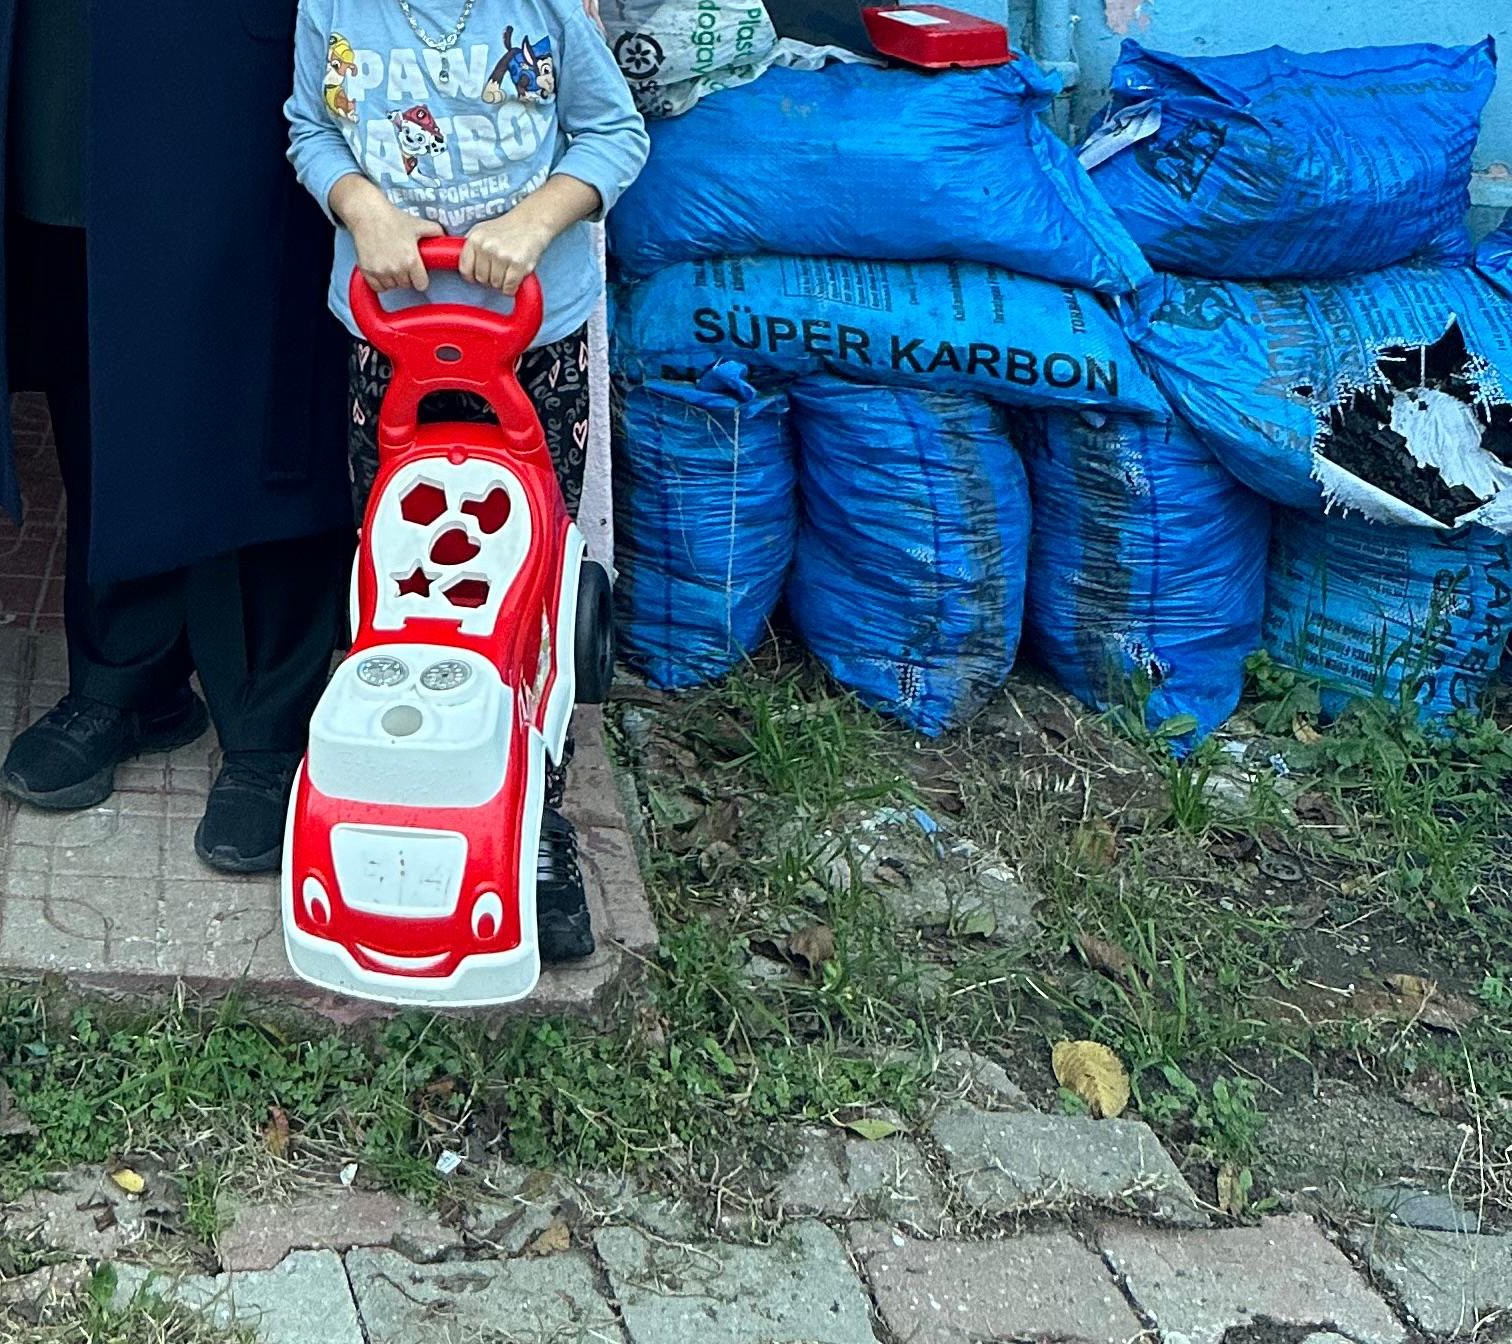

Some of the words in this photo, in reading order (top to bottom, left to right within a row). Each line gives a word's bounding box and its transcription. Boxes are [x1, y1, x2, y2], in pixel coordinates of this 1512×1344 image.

[346, 44, 488, 101] PAW
[693, 305, 872, 366] SÜPER
[890, 336, 1120, 397] KARBON
